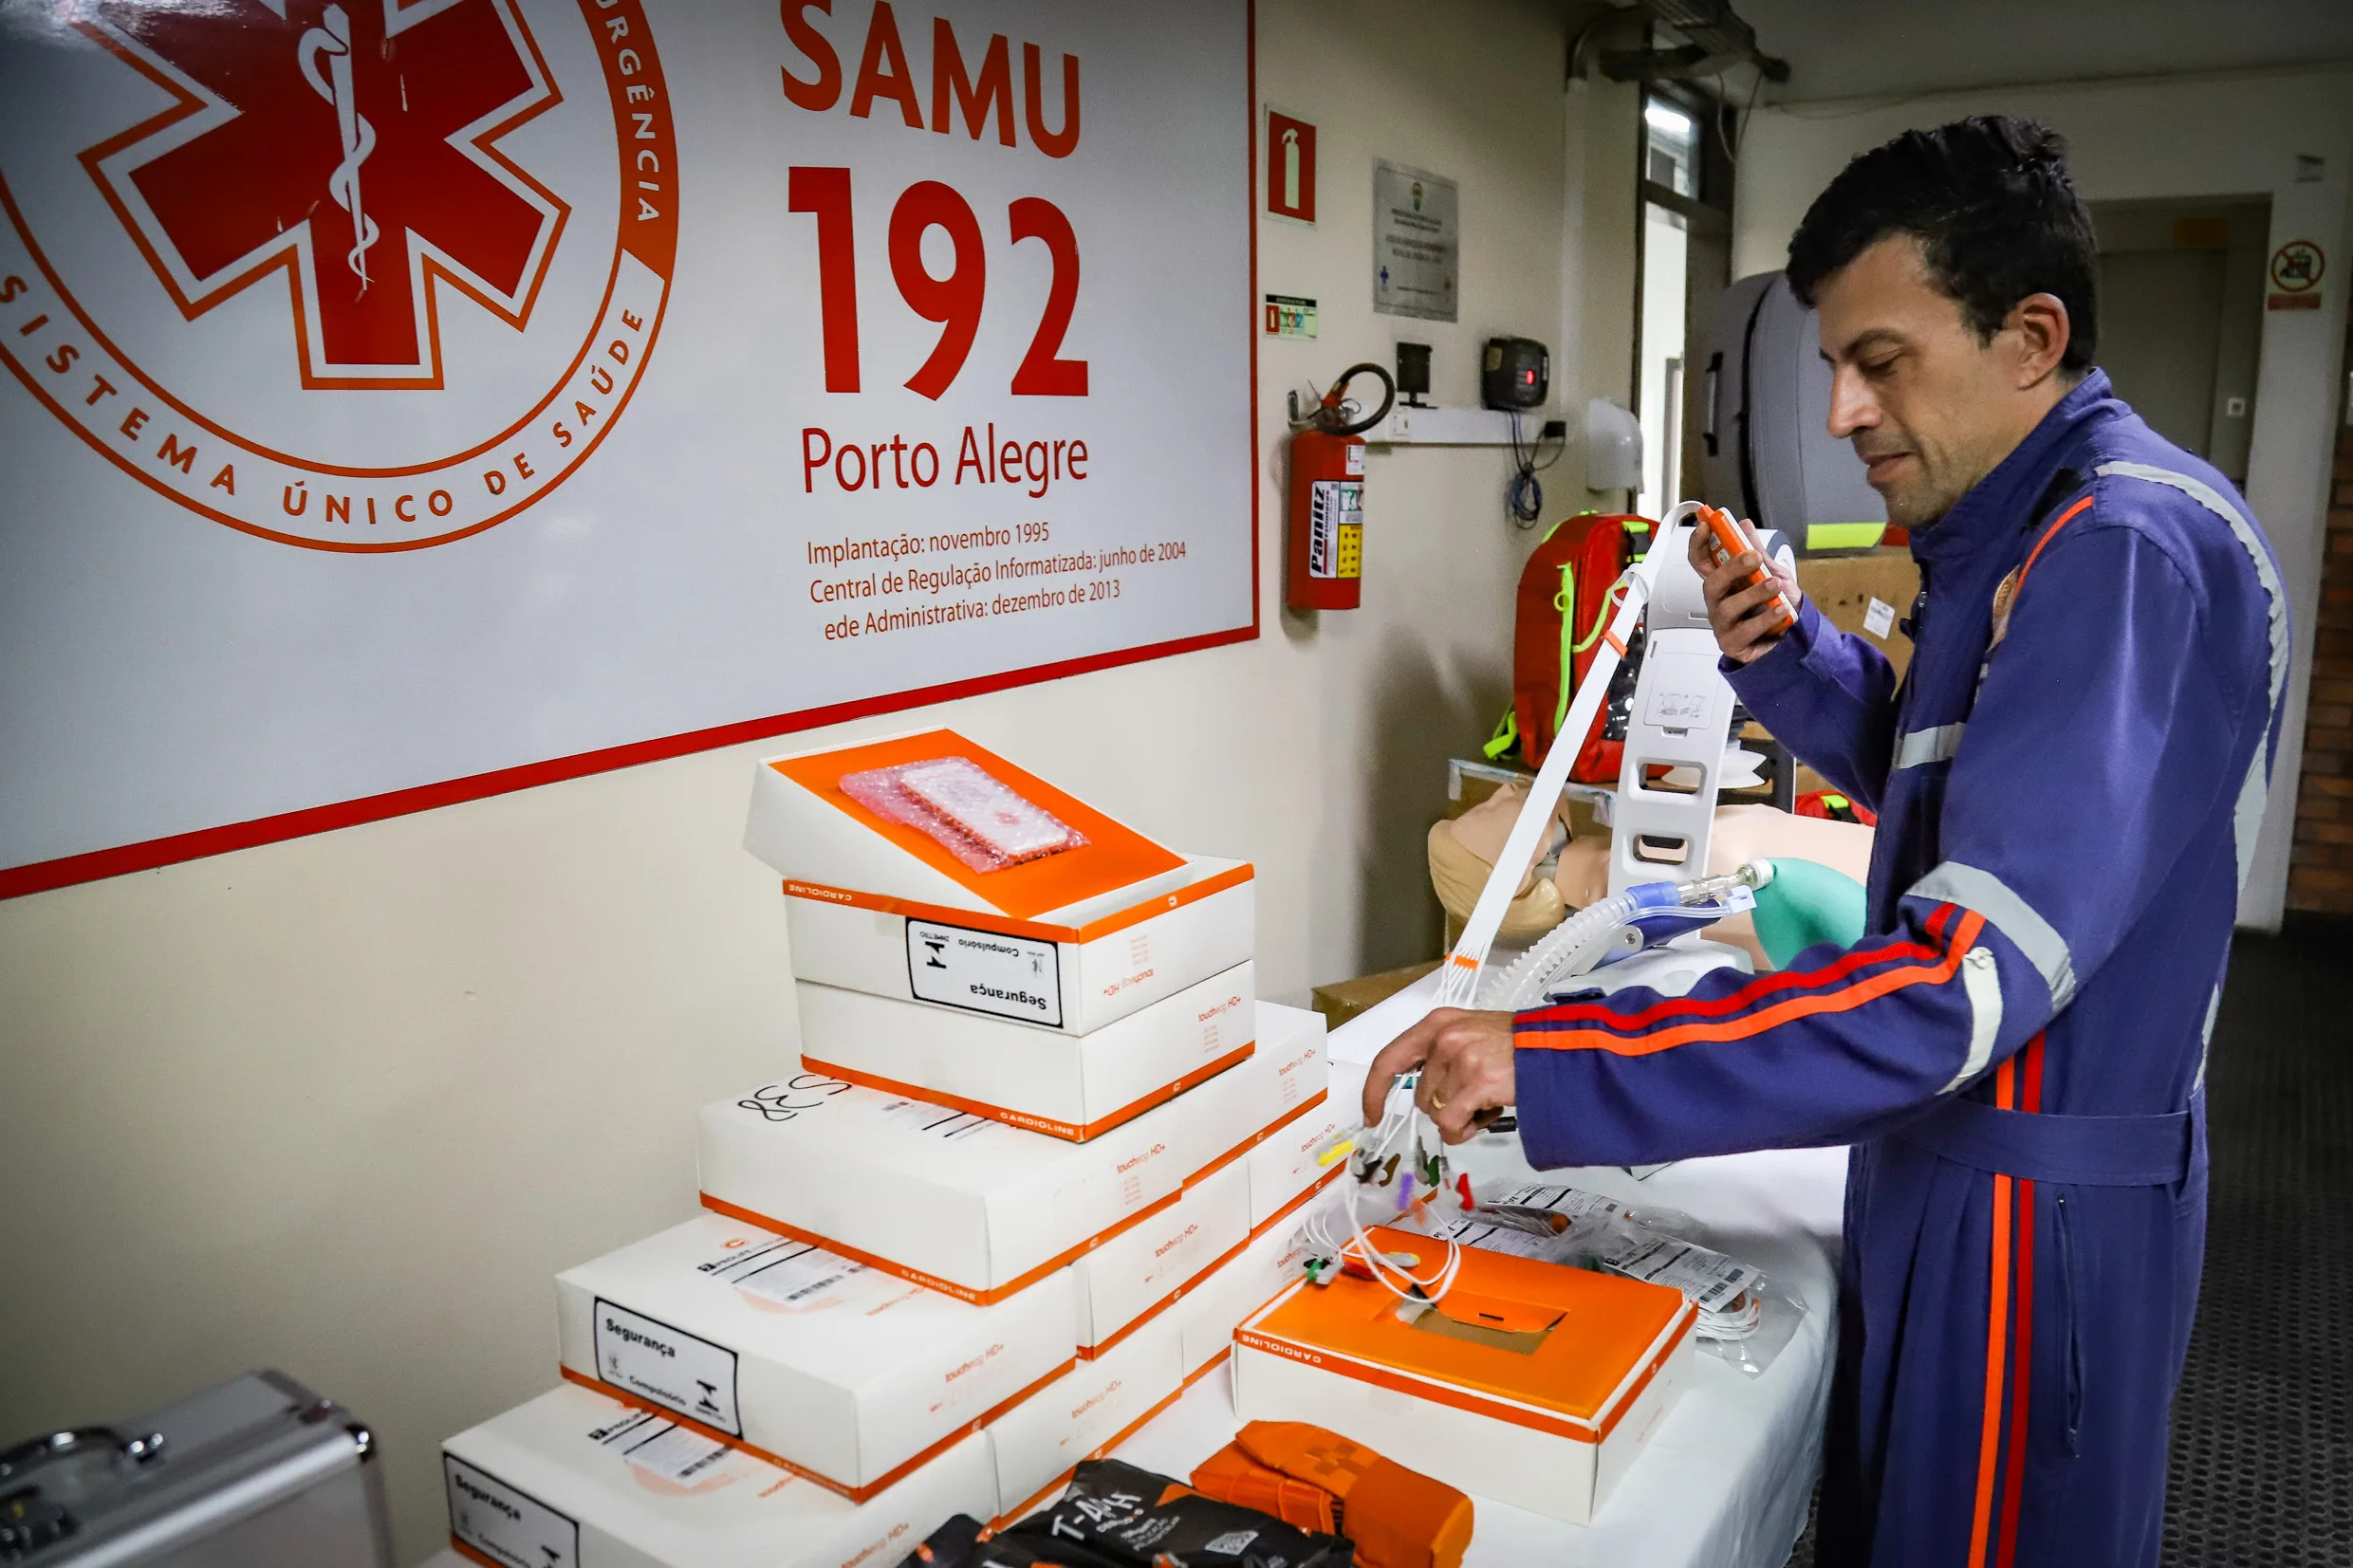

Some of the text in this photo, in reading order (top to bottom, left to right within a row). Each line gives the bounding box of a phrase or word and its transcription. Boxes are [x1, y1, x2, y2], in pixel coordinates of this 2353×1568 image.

[780, 0, 1080, 158] SAMU
[788, 166, 1088, 401] 192
[0, 275, 643, 526] SISTEMA ÚNICO DE SAÚDE
[802, 423, 1088, 499] Porto Alegre
[807, 522, 1049, 568] Implantação: novembro 1995
[1311, 485, 1325, 573] Panitz
[810, 541, 1186, 603] Central de Regulação Informatizada: junho de 2004
[864, 600, 988, 635] Administrativa:
[991, 587, 1065, 616] dezembro
[1068, 583, 1085, 604] de
[1089, 580, 1121, 601] 2013
[788, 884, 852, 901] CARDIOLINE
[958, 938, 1019, 957] Compulsório
[970, 984, 1047, 1010] Segurança
[1000, 1112, 1074, 1135] CARDIOLINE
[606, 1318, 676, 1357] Segurança
[1242, 1334, 1322, 1364] CARDIOLINE
[455, 1474, 521, 1521] Segurança
